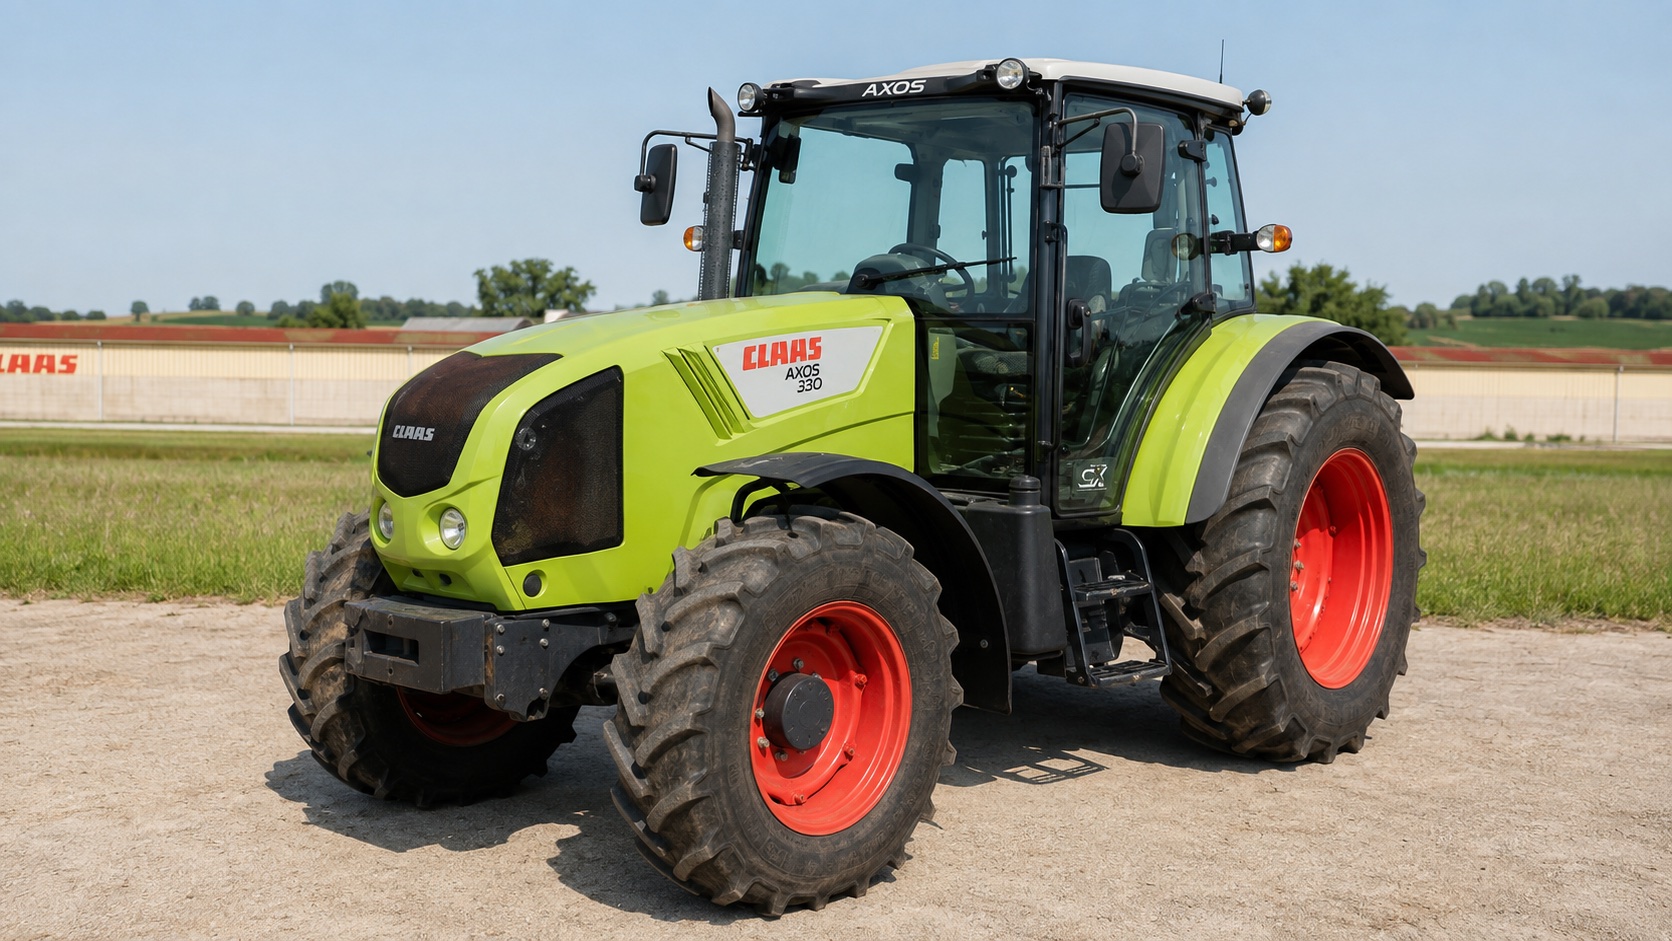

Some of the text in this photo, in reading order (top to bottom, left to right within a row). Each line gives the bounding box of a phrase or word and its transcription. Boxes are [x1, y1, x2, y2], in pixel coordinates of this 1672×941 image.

[861, 80, 927, 97] AXOS
[742, 336, 822, 371] CLAAS
[785, 363, 820, 380] AXOS
[797, 377, 823, 393] 330
[392, 424, 436, 442] CLAAS
